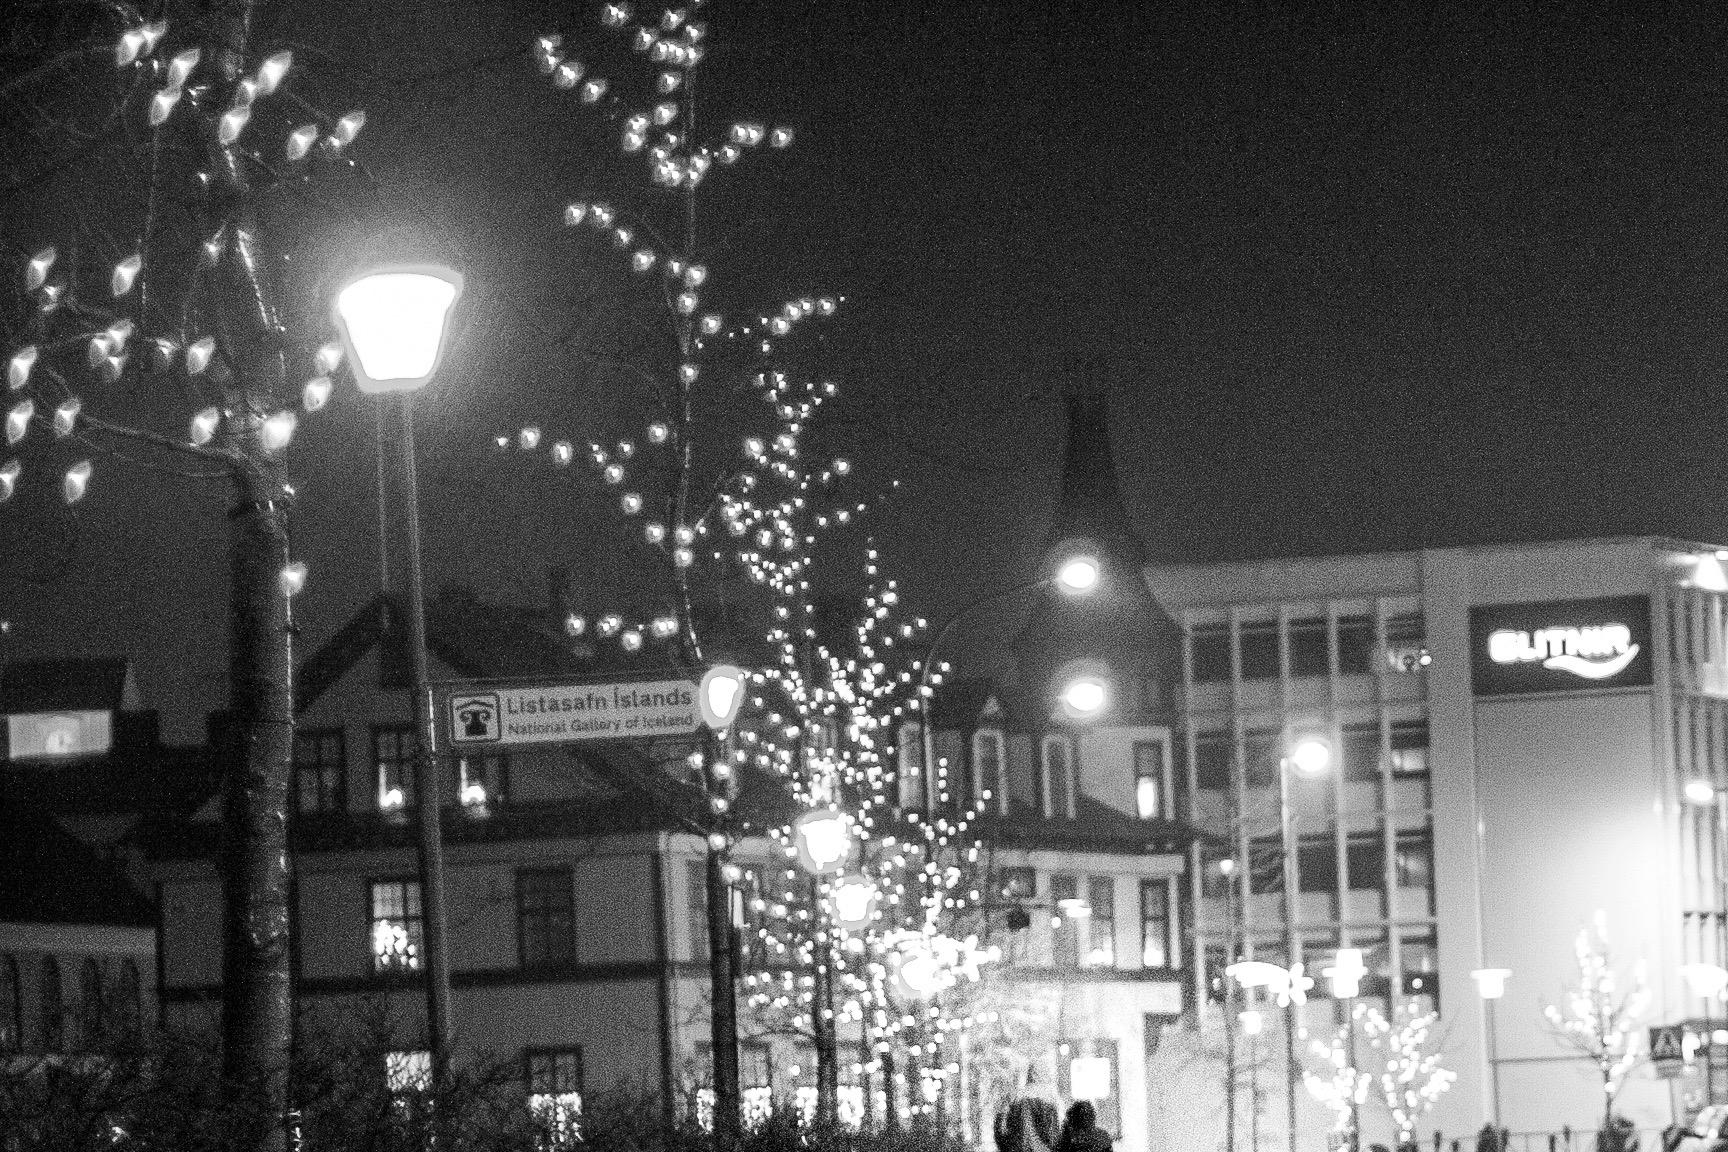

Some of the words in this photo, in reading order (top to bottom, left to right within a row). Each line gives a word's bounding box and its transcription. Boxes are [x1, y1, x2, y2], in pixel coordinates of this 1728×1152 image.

[507, 692, 607, 715] Listasafn
[508, 720, 566, 736] National
[571, 717, 621, 733] Gallery
[626, 716, 640, 729] of
[643, 714, 693, 729] Iceland
